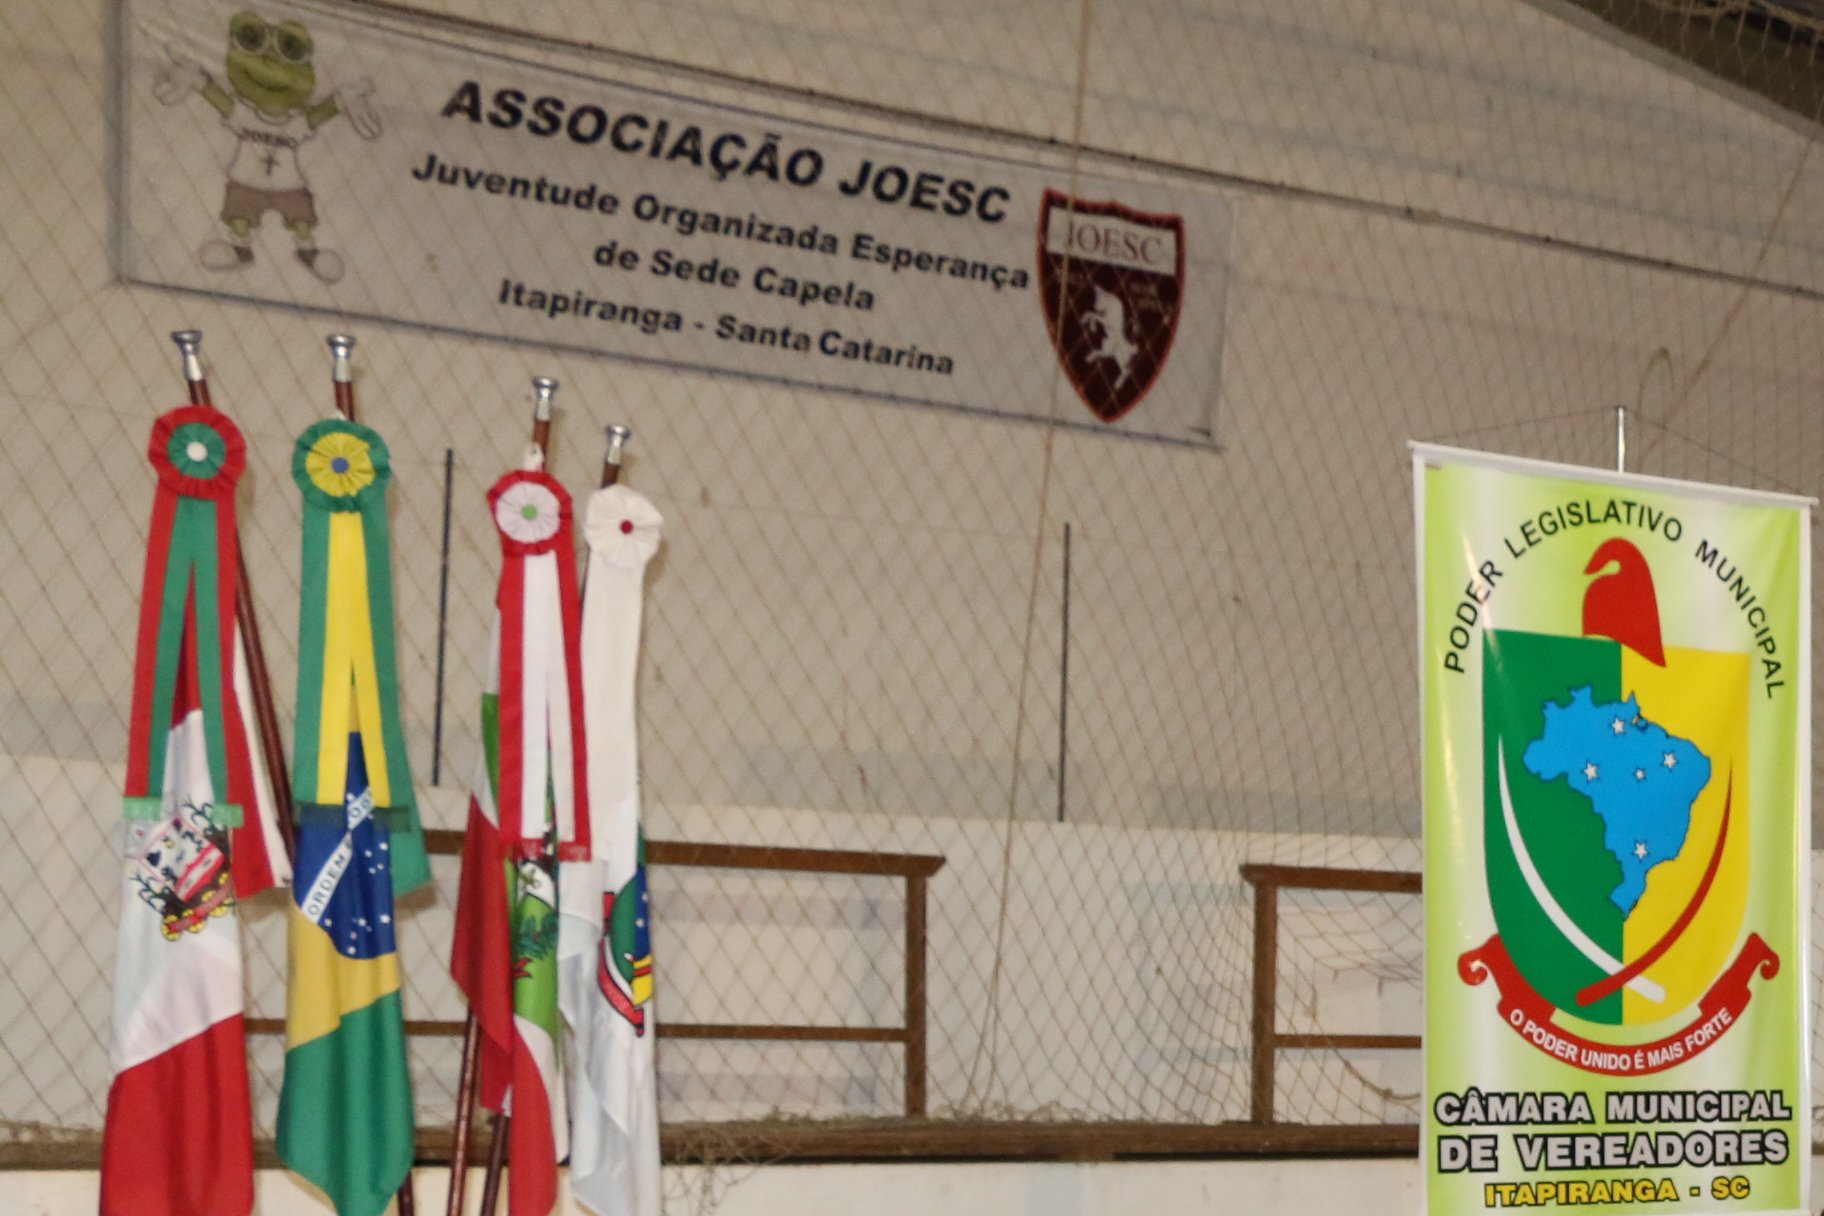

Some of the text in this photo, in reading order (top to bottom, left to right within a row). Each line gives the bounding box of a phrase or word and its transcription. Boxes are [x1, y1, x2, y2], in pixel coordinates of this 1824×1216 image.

[440, 80, 1011, 223] ASSOCIAÇÃO JOESC
[412, 153, 1030, 292] Juventude Organizada Esperança
[594, 239, 875, 311] de Sede Capela
[499, 278, 683, 335] Itapiranga
[715, 314, 811, 352] Santa
[819, 330, 955, 375] Catarina
[1443, 499, 1786, 699] PODER LEGISLATIVO MUNICIPAL
[1510, 1007, 1732, 1071] O PODER UNIDO É MAIS FORTE
[1434, 1086, 1792, 1126] CÂMARA MUNICIPAL
[1437, 1129, 1789, 1173] DE VEREADORES
[1484, 1175, 1751, 1208] ITAPIRANGA - SC
